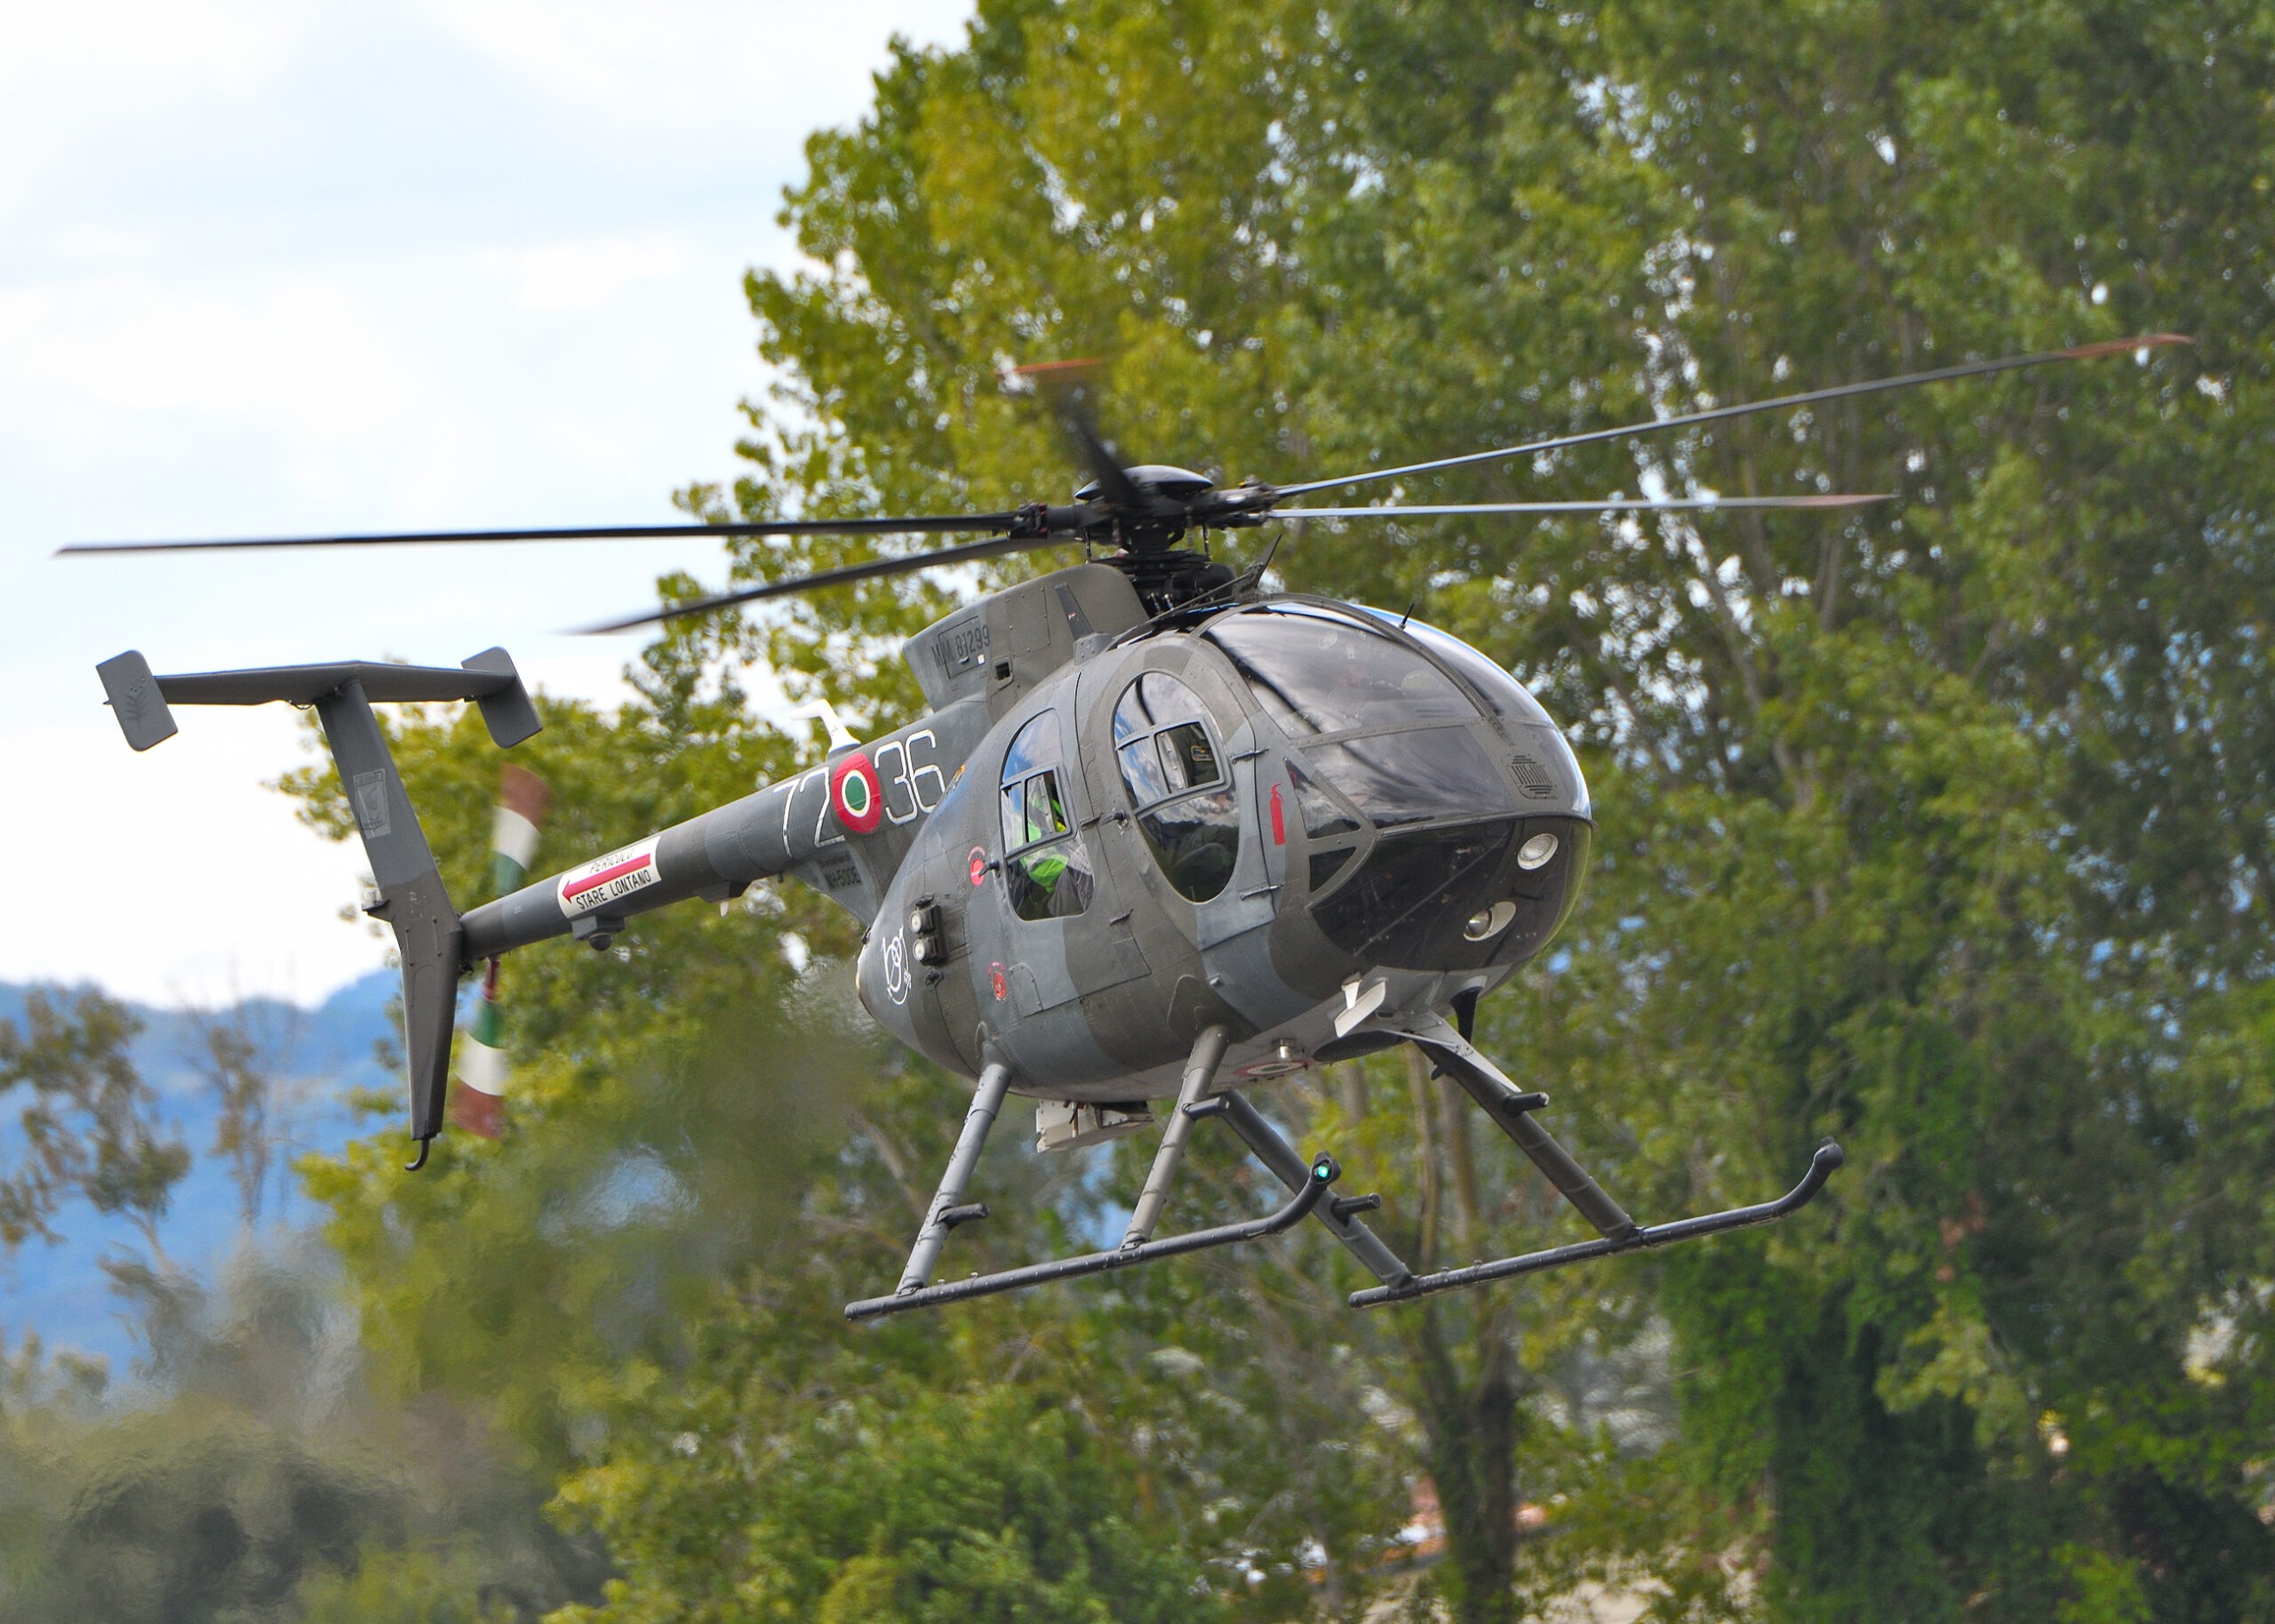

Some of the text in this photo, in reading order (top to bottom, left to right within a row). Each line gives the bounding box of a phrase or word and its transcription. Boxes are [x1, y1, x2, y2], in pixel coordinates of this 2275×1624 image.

[955, 625, 990, 657] 81299
[773, 729, 946, 858] 72 36
[576, 869, 651, 910] STARE LONTANO
